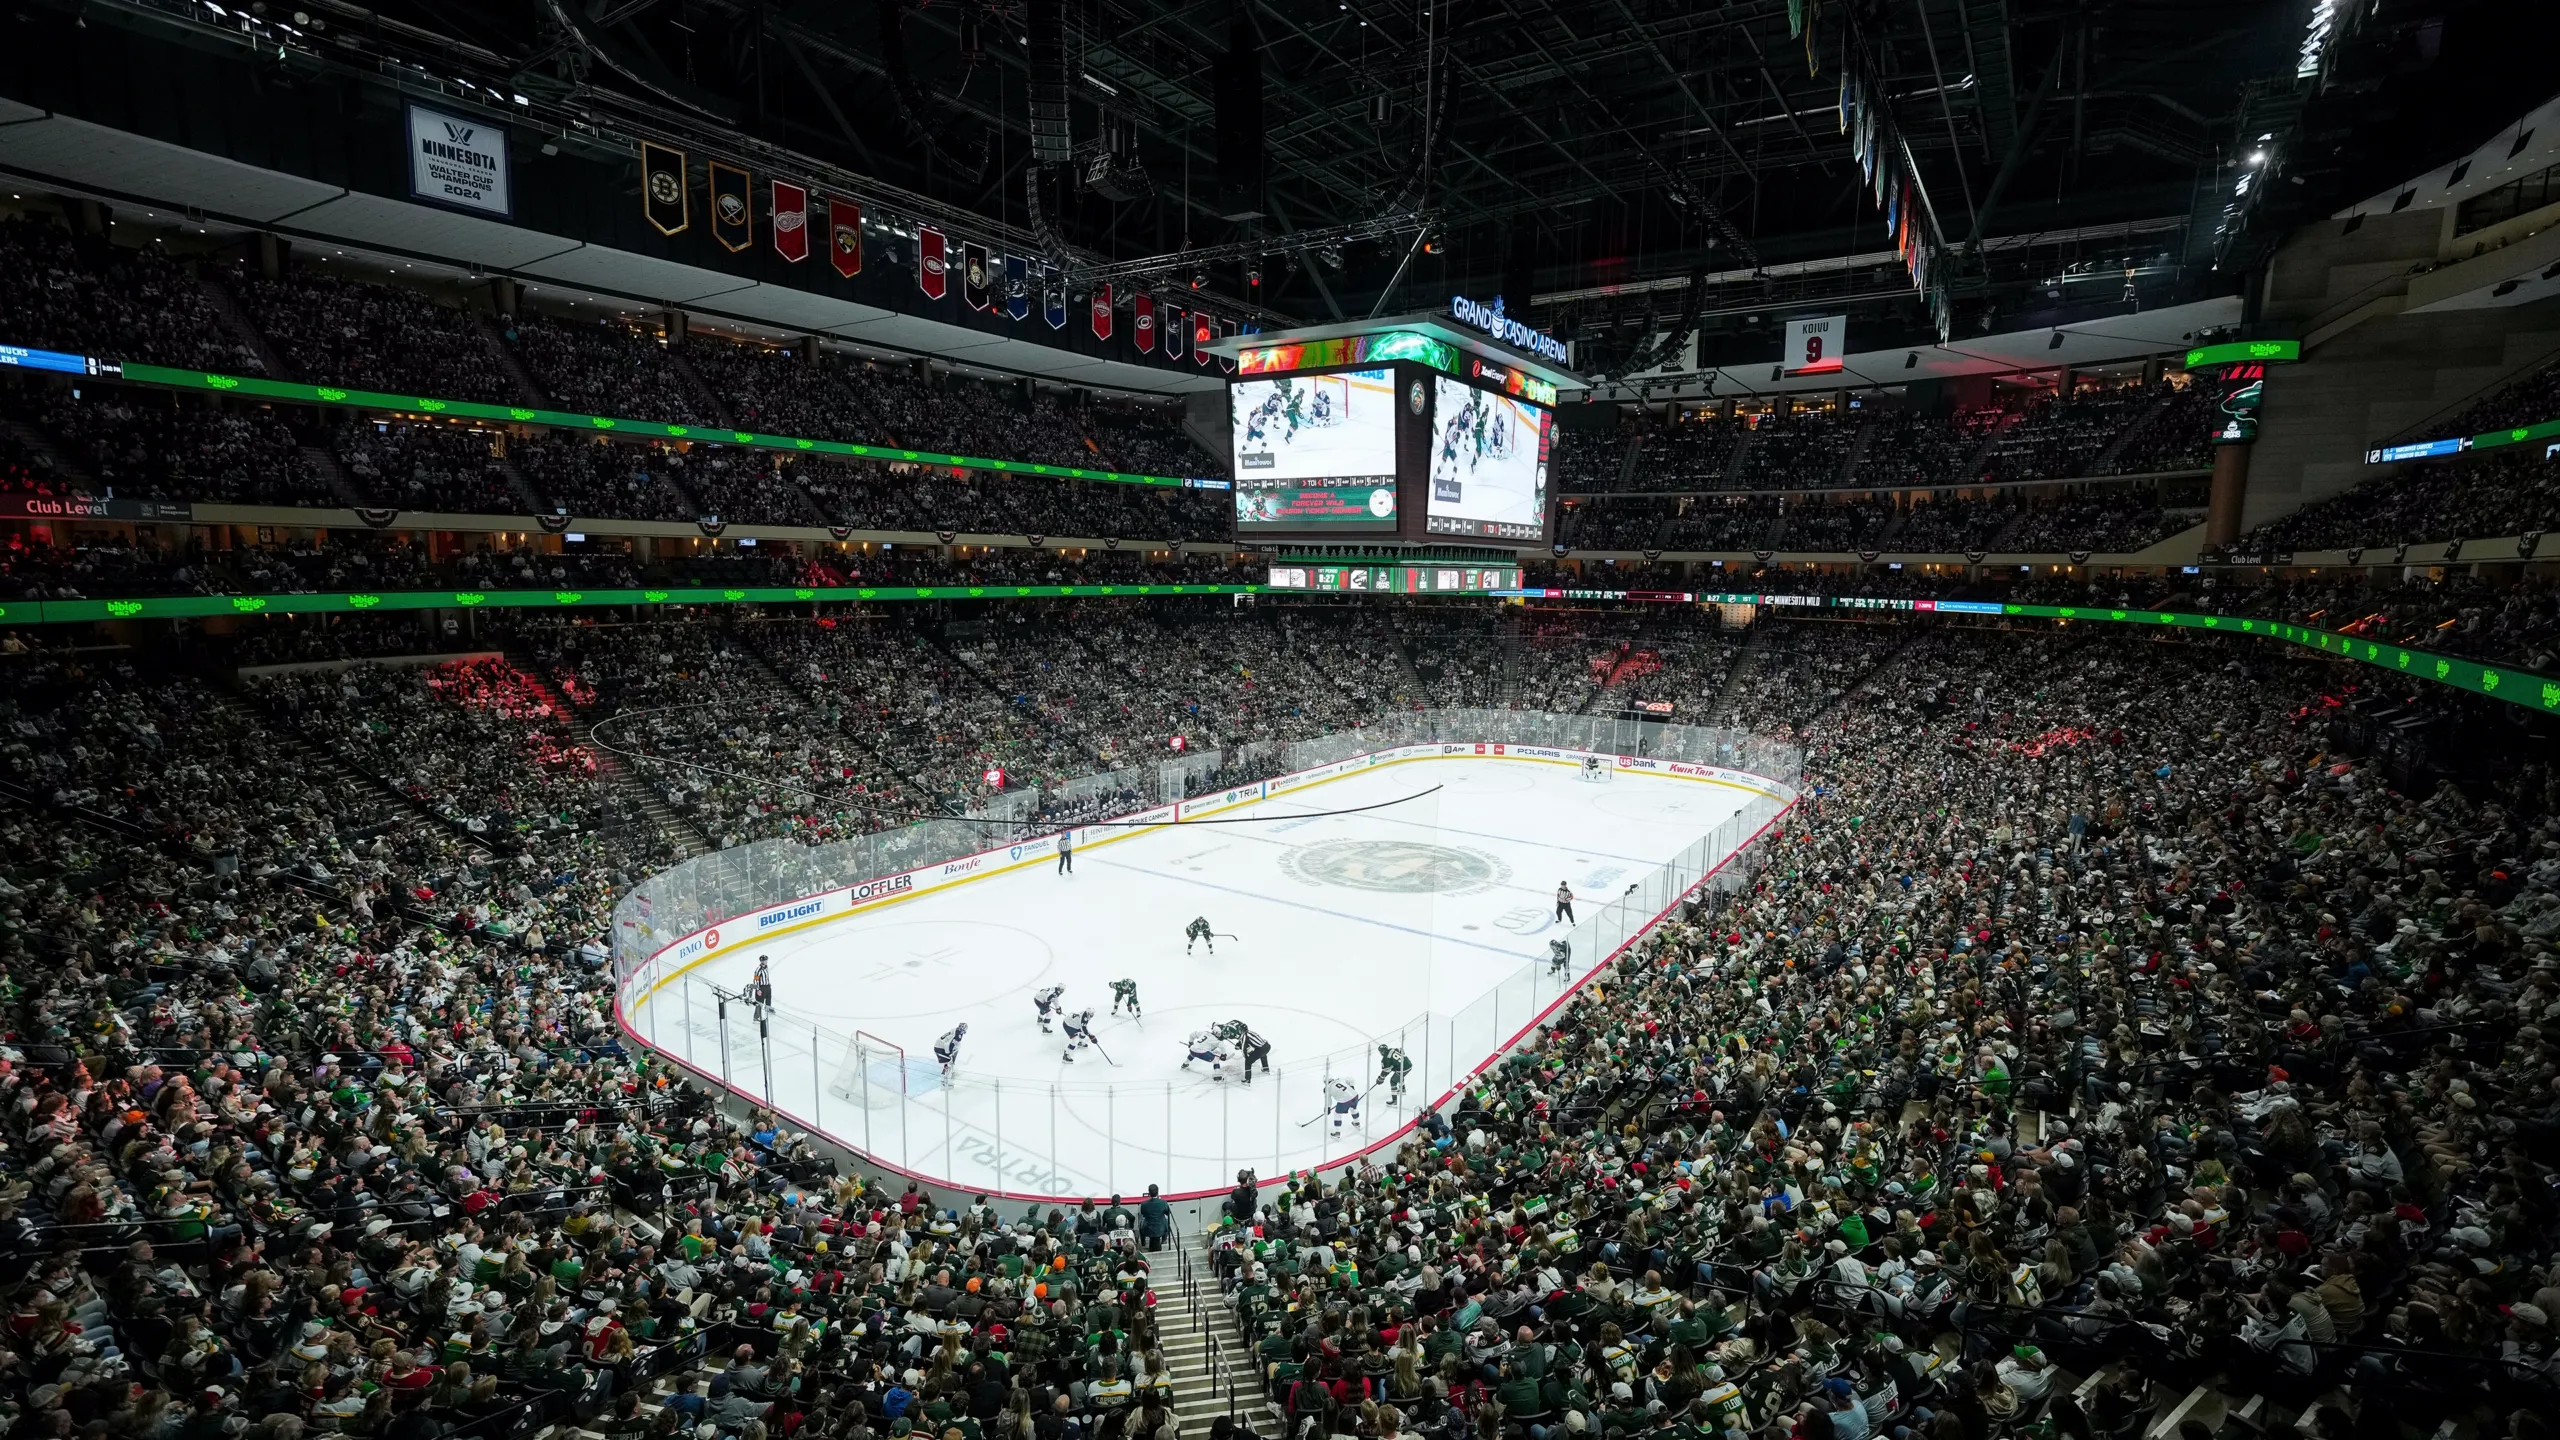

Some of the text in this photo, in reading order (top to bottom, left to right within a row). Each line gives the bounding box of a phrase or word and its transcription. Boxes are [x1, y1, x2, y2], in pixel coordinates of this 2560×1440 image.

[422, 138, 497, 171] MINNESOTA
[428, 163, 494, 184] WALTER CUP
[430, 171, 492, 191] CHAMPIONS
[444, 184, 481, 200] 2024
[1453, 296, 1567, 364] GRAND CASINO ARENA
[1802, 321, 1829, 334] KOIVU
[1806, 336, 1823, 364] 9
[2250, 344, 2281, 355] bibigo
[207, 375, 238, 388] bibigo
[26, 500, 109, 516] Club Level
[2231, 554, 2261, 564] Club Level
[1318, 574, 1335, 583] 8:27
[233, 597, 266, 609] bibigo
[1774, 595, 1821, 607] MINNESOTA WILD
[108, 602, 142, 614] bibigo
[1517, 747, 1561, 758] POLARIS
[1633, 758, 1656, 769] bank
[1669, 763, 1694, 775] KWIK
[1694, 766, 1715, 777] TRIP
[1238, 787, 1258, 799] TRIA
[1148, 811, 1169, 822] CANNON
[1024, 840, 1050, 852] FANDUEL
[943, 857, 981, 875] Bonfe
[851, 874, 912, 900] LOFFLER
[760, 901, 822, 927] BUD LIGHT
[679, 940, 702, 959] BMO
[2129, 1178, 2142, 1188] 32
[266, 1213, 279, 1223] 97
[1250, 1302, 1268, 1315] 12
[1264, 1320, 1282, 1330] SPURGE
[2189, 1333, 2205, 1347] 12
